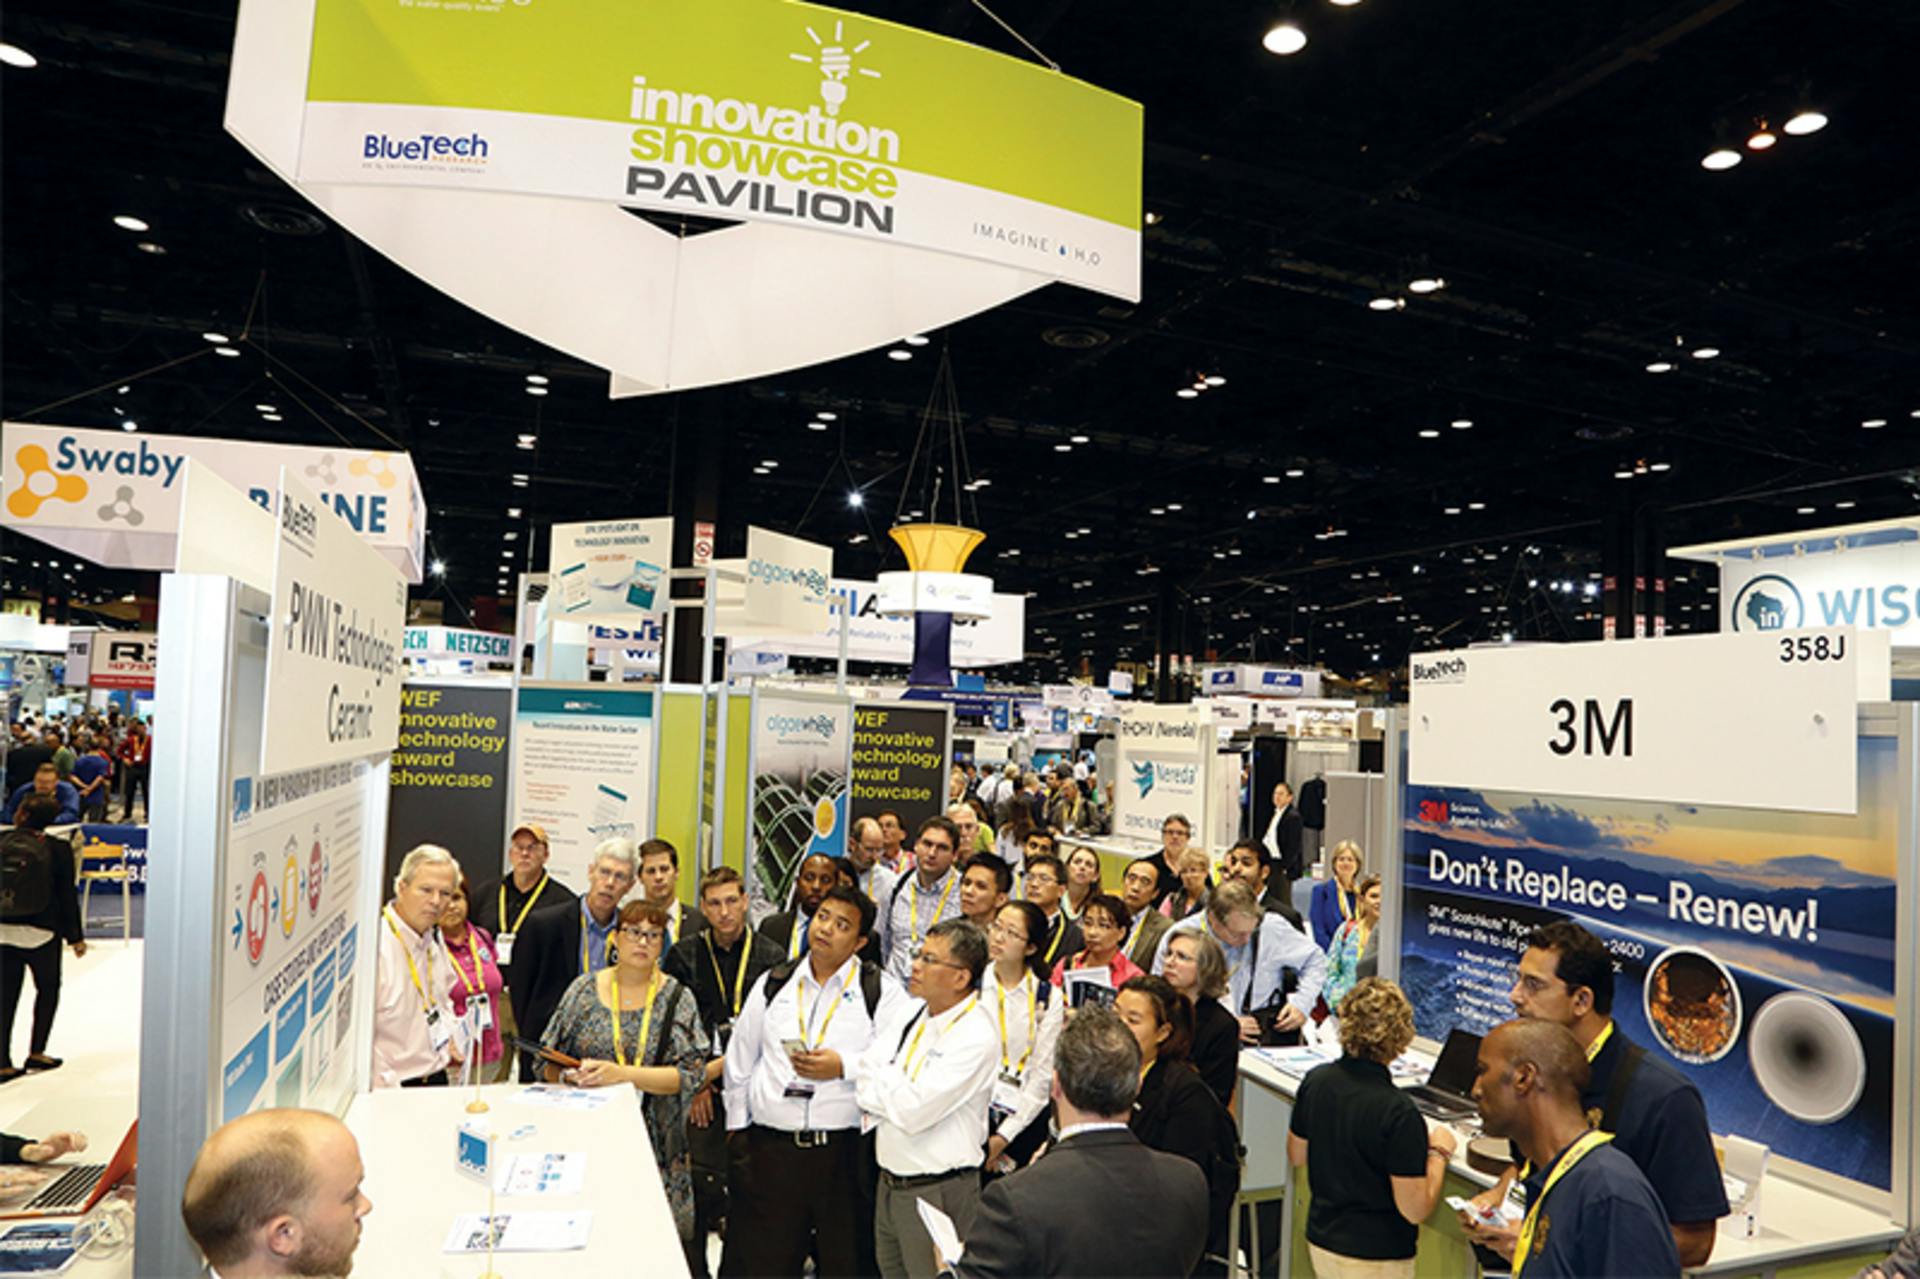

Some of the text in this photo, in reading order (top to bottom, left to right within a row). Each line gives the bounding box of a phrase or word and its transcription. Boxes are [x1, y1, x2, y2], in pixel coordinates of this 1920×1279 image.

[630, 76, 899, 162] innovation
[364, 133, 488, 161] BlueTech
[630, 129, 898, 199] showcase
[626, 166, 894, 233] PAVILION
[973, 221, 1049, 253] IMAGINE
[56, 436, 184, 488] Swaby
[288, 581, 331, 659] PWN
[446, 633, 511, 656] NETZSCH
[1780, 635, 1845, 663] 358J
[1413, 657, 1467, 680] BlueTech
[328, 683, 373, 743] Ceramic
[400, 711, 498, 730] nnovative
[853, 731, 935, 749] nnovative
[1548, 698, 1634, 757] 3M
[400, 730, 505, 753] echnology
[391, 750, 455, 768] award
[852, 747, 942, 769] echnology
[390, 768, 494, 788] showcase
[851, 782, 932, 802] howcase
[1419, 800, 1448, 823] 3M
[1428, 848, 1499, 891] Don't
[1505, 858, 1627, 910] Replace
[1668, 880, 1818, 943] Renew!
[1427, 921, 1451, 936] gives
[1453, 927, 1472, 940] new
[1472, 927, 1488, 944] life
[1490, 932, 1500, 948] to
[1502, 935, 1518, 951] old
[1509, 917, 1533, 937] Pipe
[1609, 939, 1646, 959] 2400
